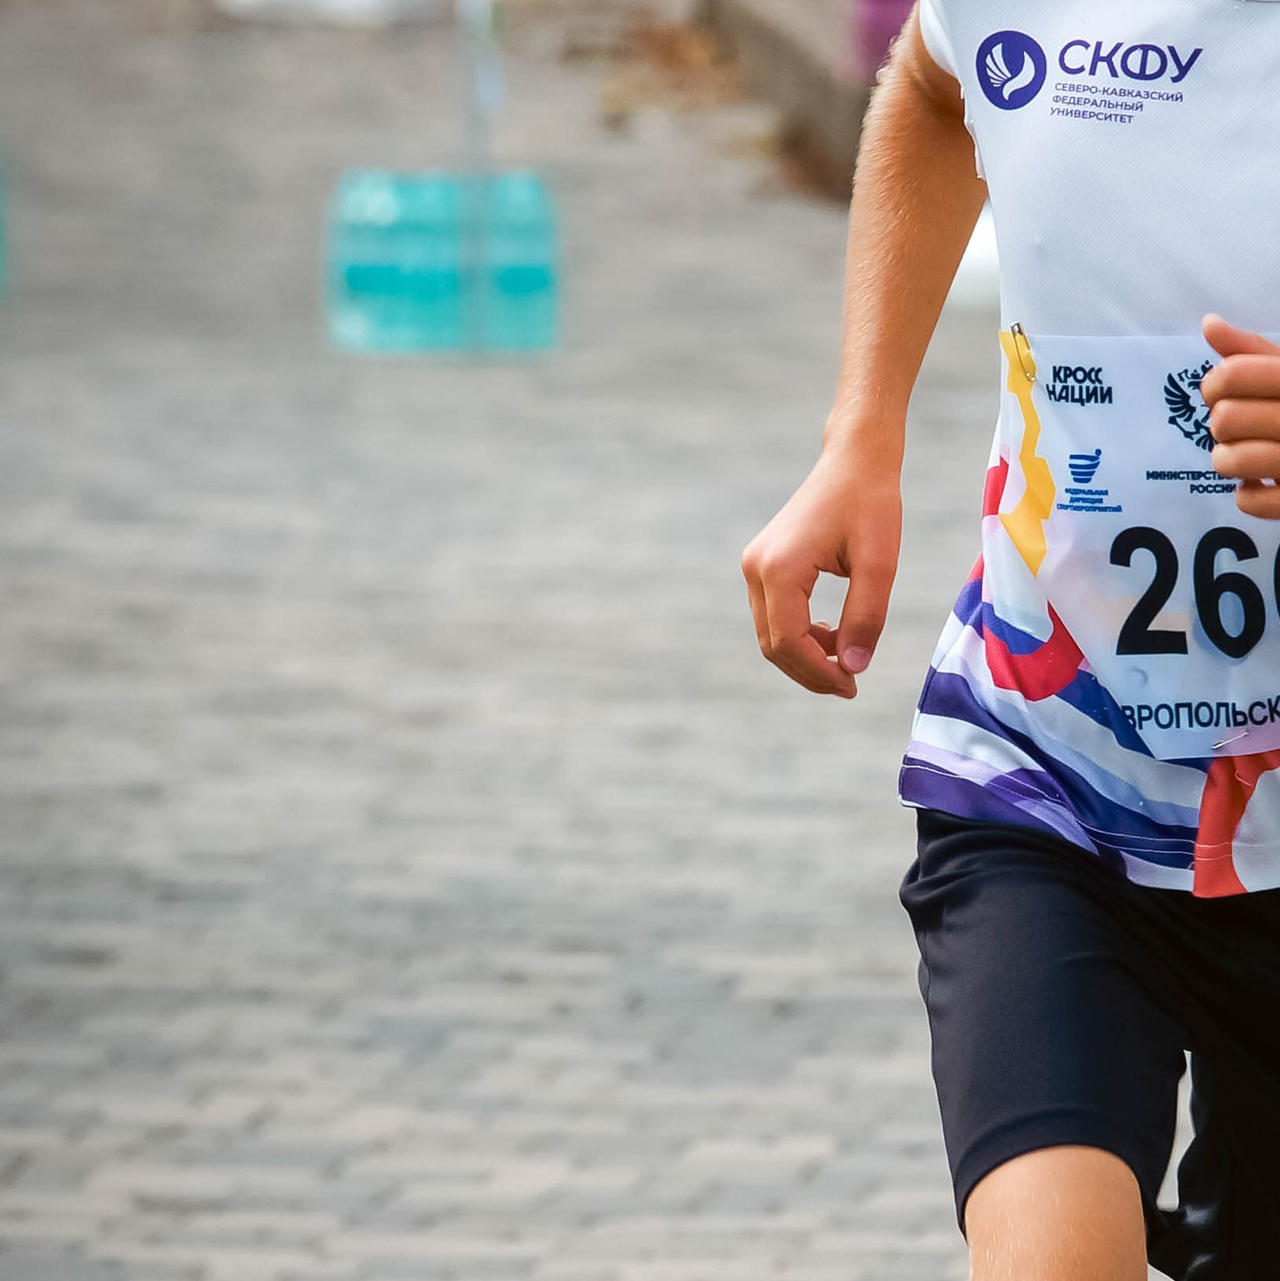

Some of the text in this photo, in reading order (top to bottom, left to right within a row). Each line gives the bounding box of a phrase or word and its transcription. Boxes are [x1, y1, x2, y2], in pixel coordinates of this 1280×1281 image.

[1058, 40, 1203, 83] СКФУ
[1055, 82, 1184, 103] СЕВЕРО-КАВКАЗСКИЙ
[1052, 95, 1143, 112] ФЕДЕРАЛЬНЫЙ
[1050, 107, 1134, 124] УНИВЕРСИТЕТ
[1052, 366, 1103, 385] КРОСС
[1046, 384, 1113, 407] НАЦИИ
[1190, 484, 1237, 494] РОССИИ
